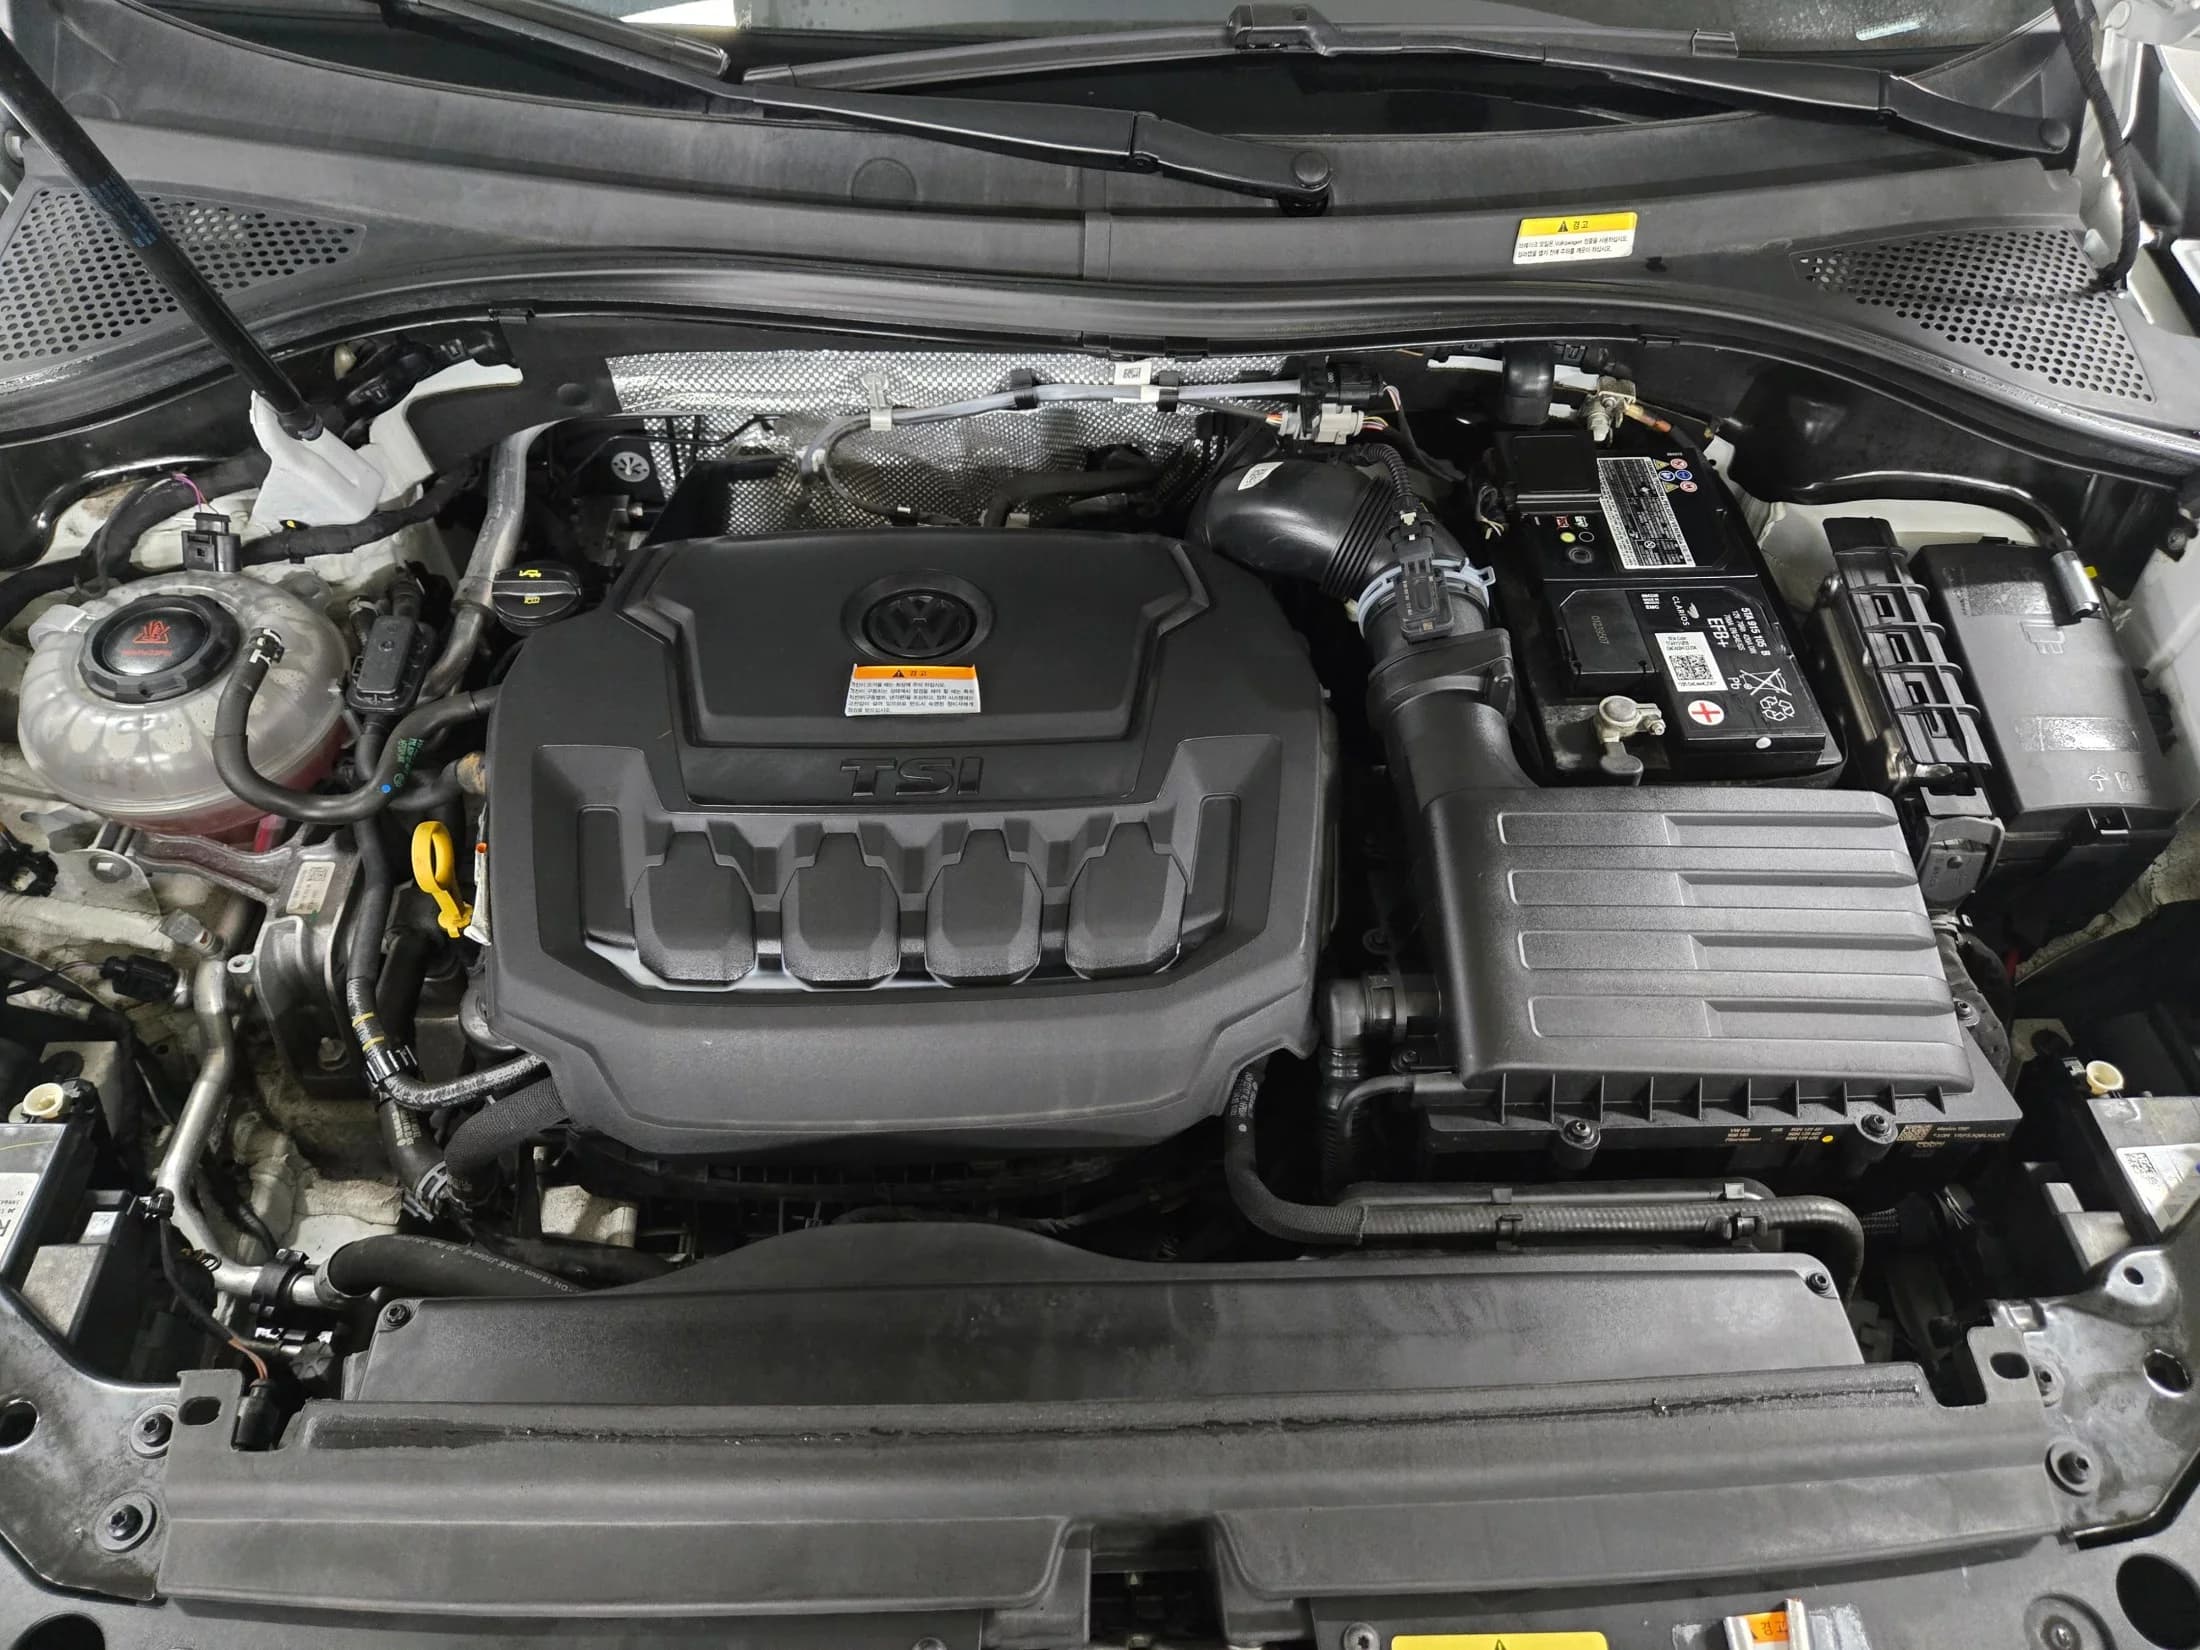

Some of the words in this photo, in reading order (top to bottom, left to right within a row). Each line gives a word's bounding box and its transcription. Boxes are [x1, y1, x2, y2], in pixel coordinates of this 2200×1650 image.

[1671, 595, 1690, 626] CLARIOS
[1741, 607, 1754, 620] 5TA
[1707, 617, 1730, 648] EFB+
[1747, 621, 1761, 633] 915
[1753, 635, 1767, 647] 105
[1728, 677, 1742, 690] Pb
[840, 757, 984, 797] TSI
